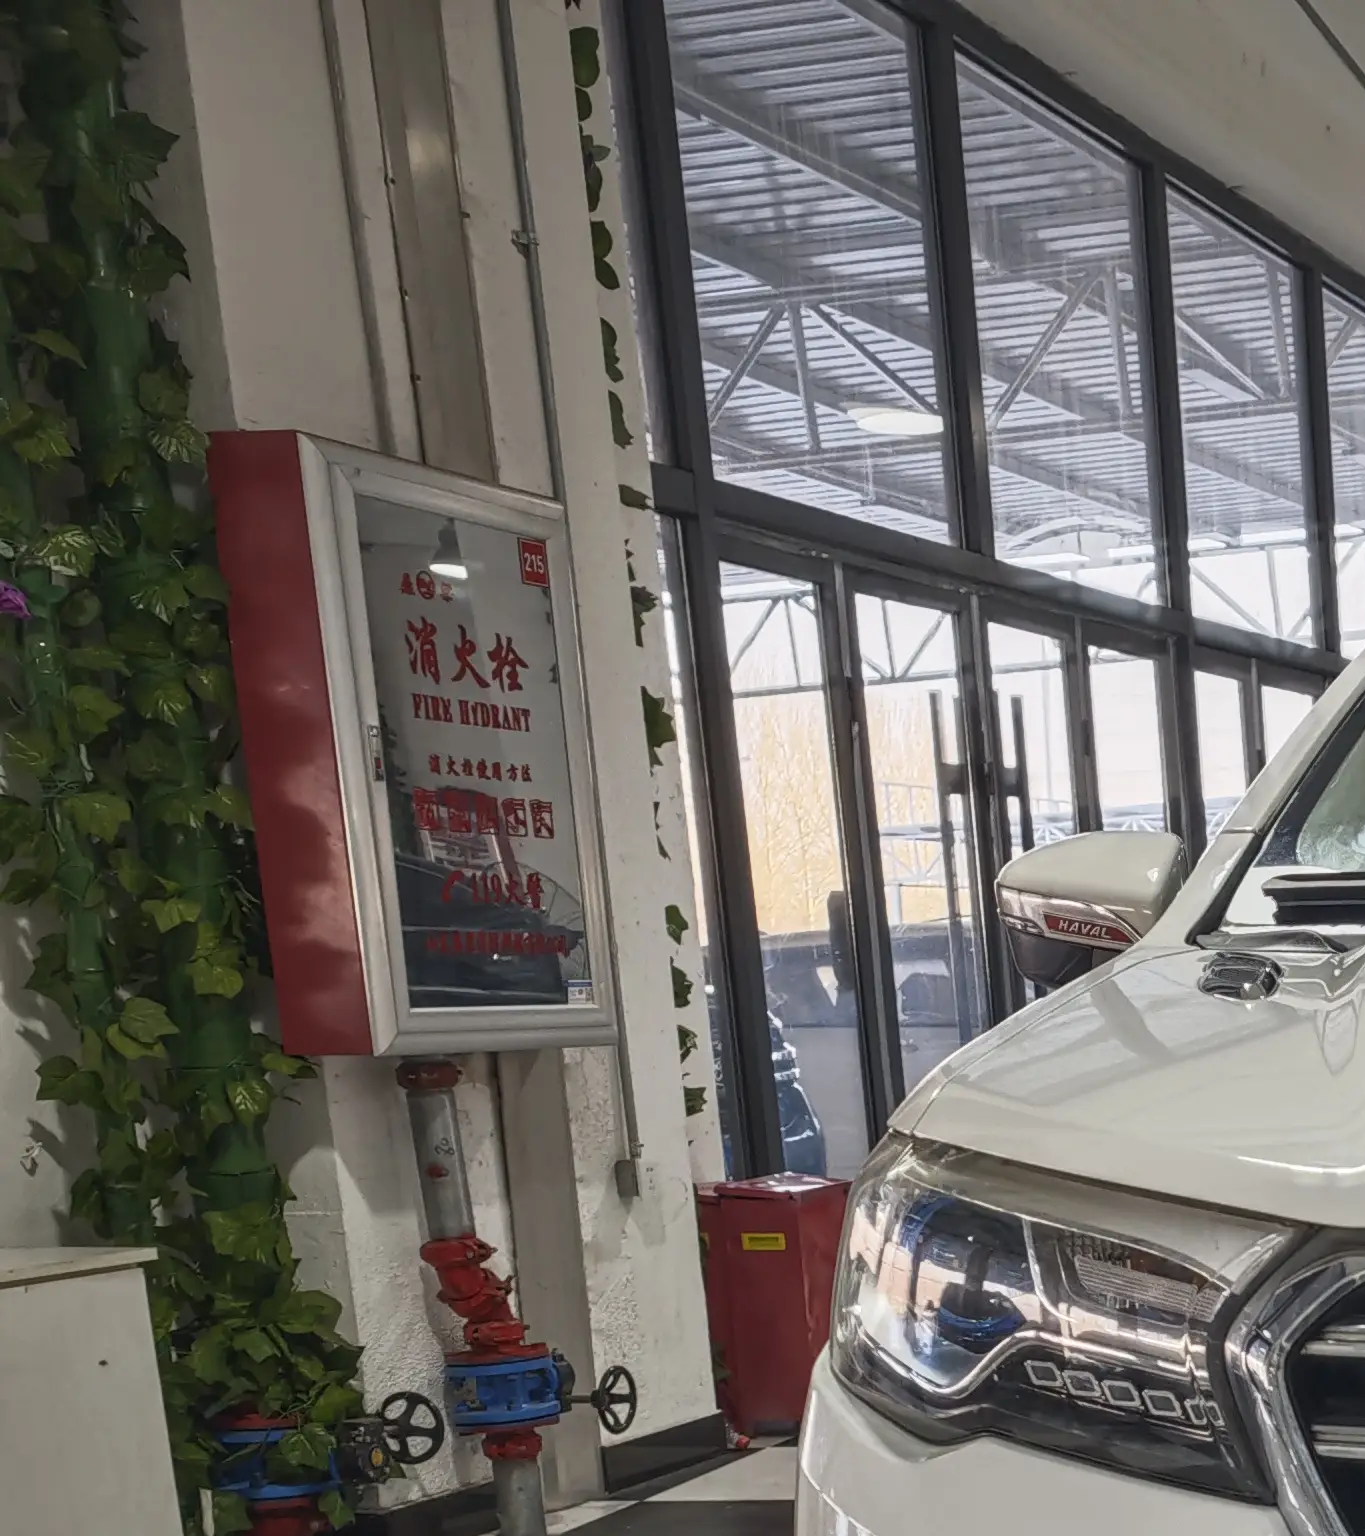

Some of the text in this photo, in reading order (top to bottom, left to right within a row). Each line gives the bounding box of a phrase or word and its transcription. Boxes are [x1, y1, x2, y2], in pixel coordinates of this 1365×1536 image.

[524, 552, 545, 574] 215
[404, 616, 529, 693] 消火栓
[411, 693, 532, 732] FIRE HYDRANT
[429, 754, 532, 782] 消火栓使用方法
[471, 872, 544, 909] 119火警
[1058, 919, 1113, 939] HAVAL
